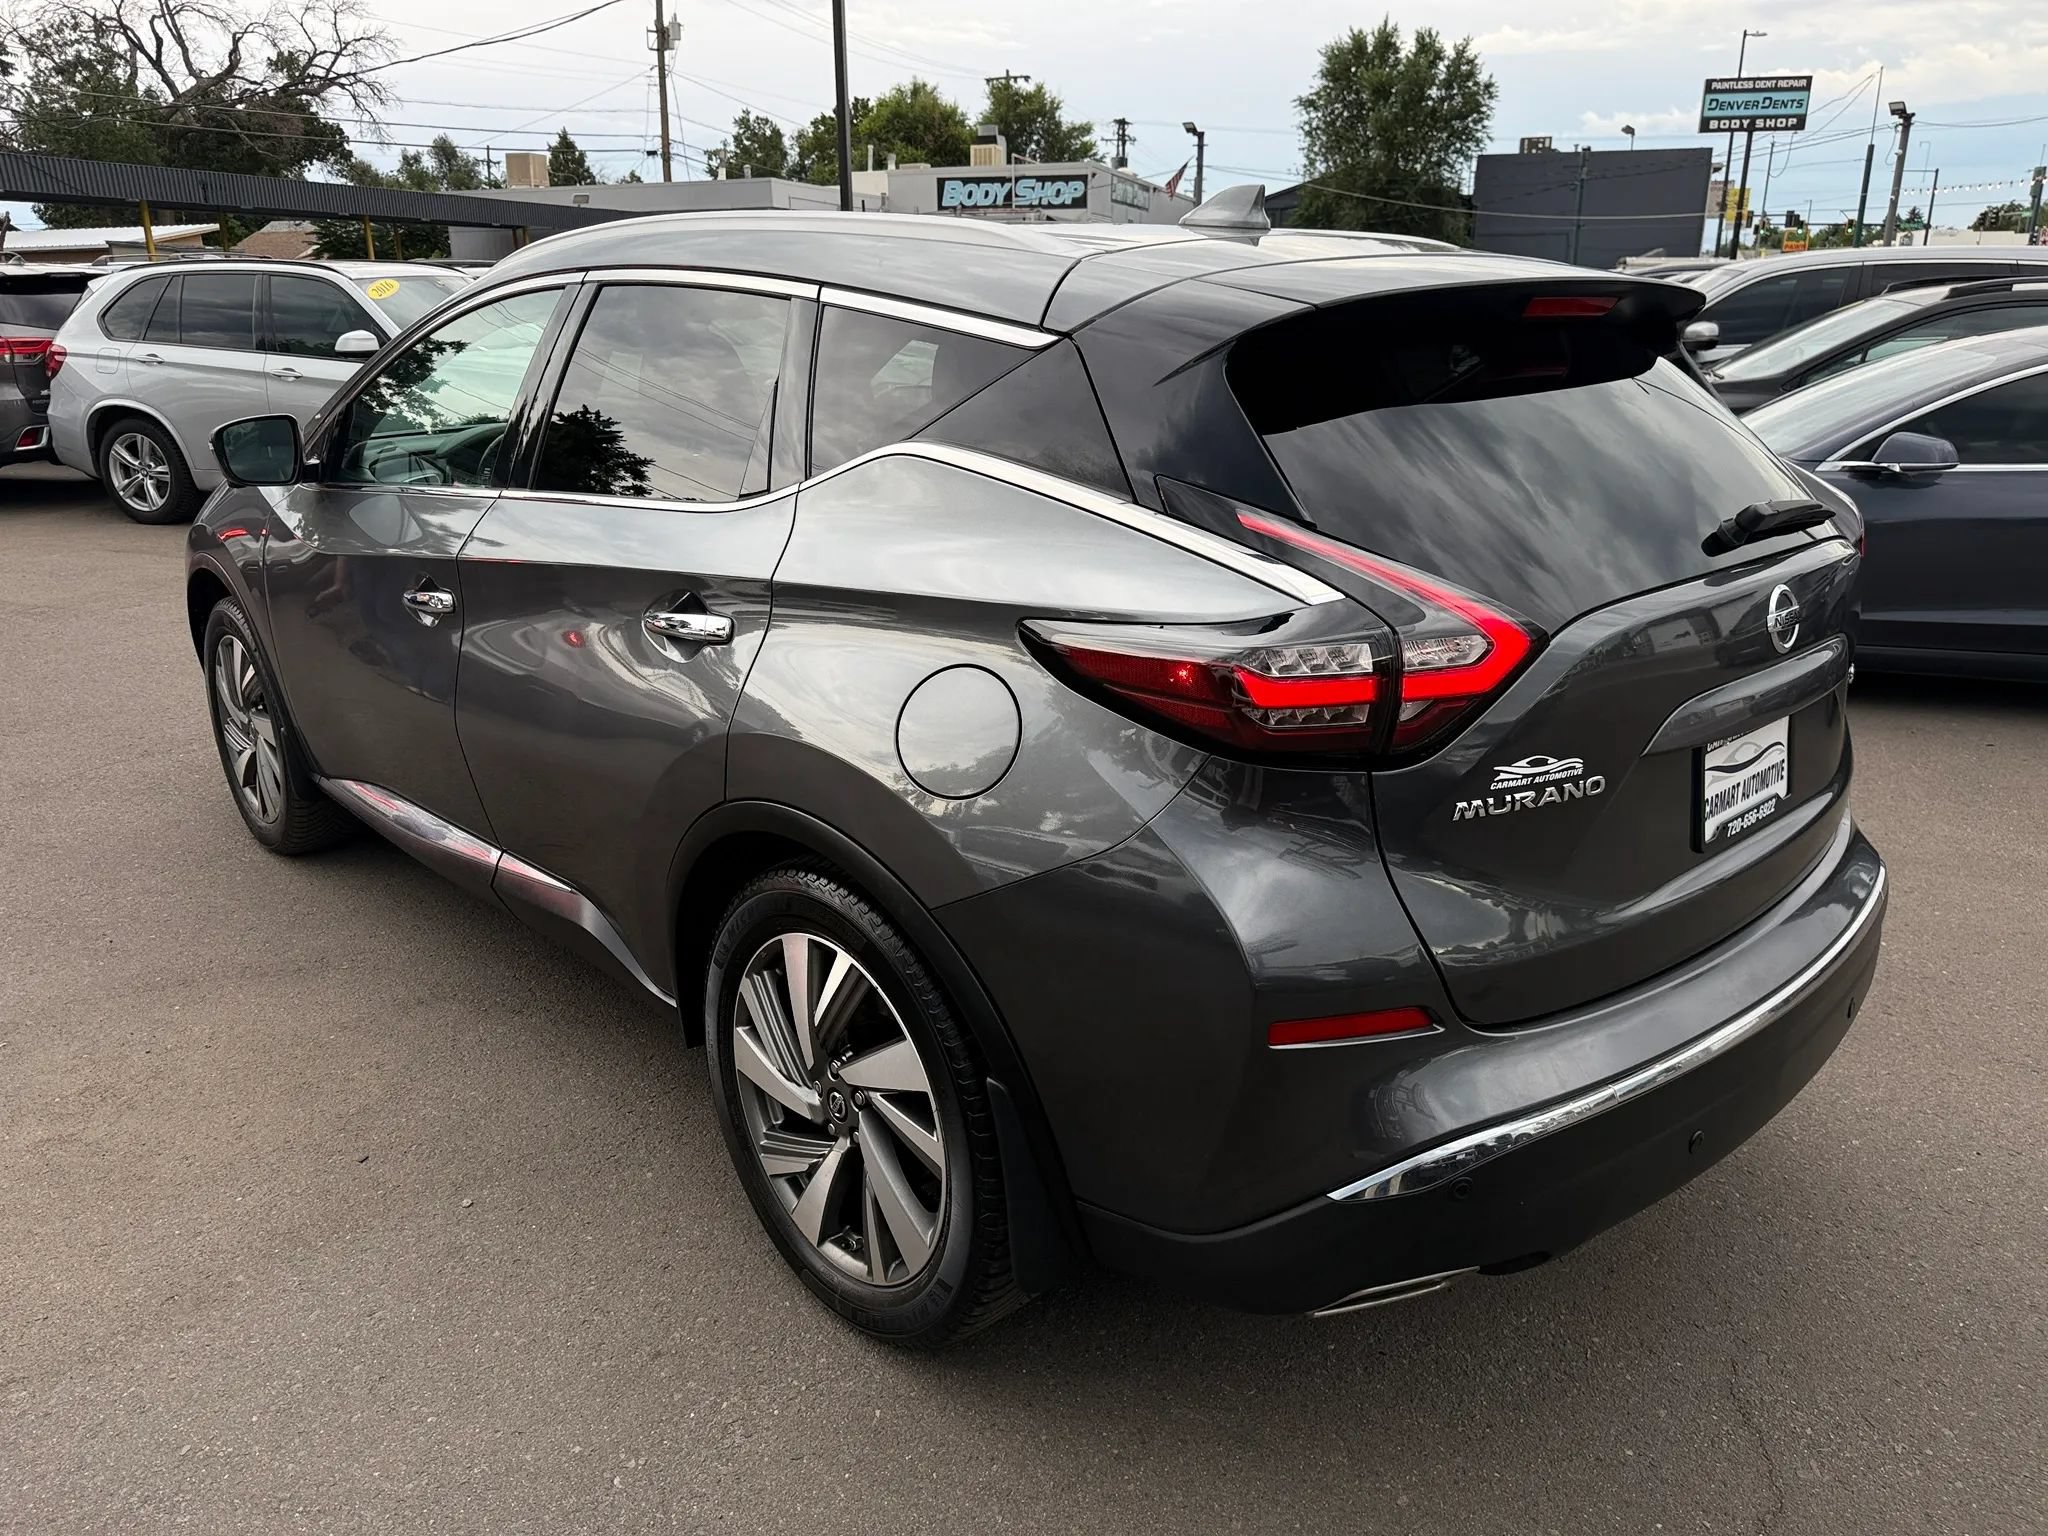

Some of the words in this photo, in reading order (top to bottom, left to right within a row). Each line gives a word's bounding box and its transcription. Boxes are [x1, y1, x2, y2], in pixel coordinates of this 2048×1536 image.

[1711, 80, 1754, 90] PAINTLESS
[1754, 80, 1777, 89] DENT
[1777, 79, 1807, 88] REPAIR
[1709, 119, 1751, 129] BODY
[1755, 117, 1798, 128] SHOP
[941, 180, 1013, 207] BODY
[1015, 178, 1085, 205] SHOP
[371, 280, 394, 297] 2016
[1490, 777, 1533, 790] CARMART
[1533, 767, 1584, 784] AUTOMOTIVE
[1705, 781, 1741, 821] CARMART
[1741, 758, 1785, 803] AUTOMOTIVE
[1452, 775, 1606, 821] MURANO
[1727, 798, 1777, 838] 720-656-6922
